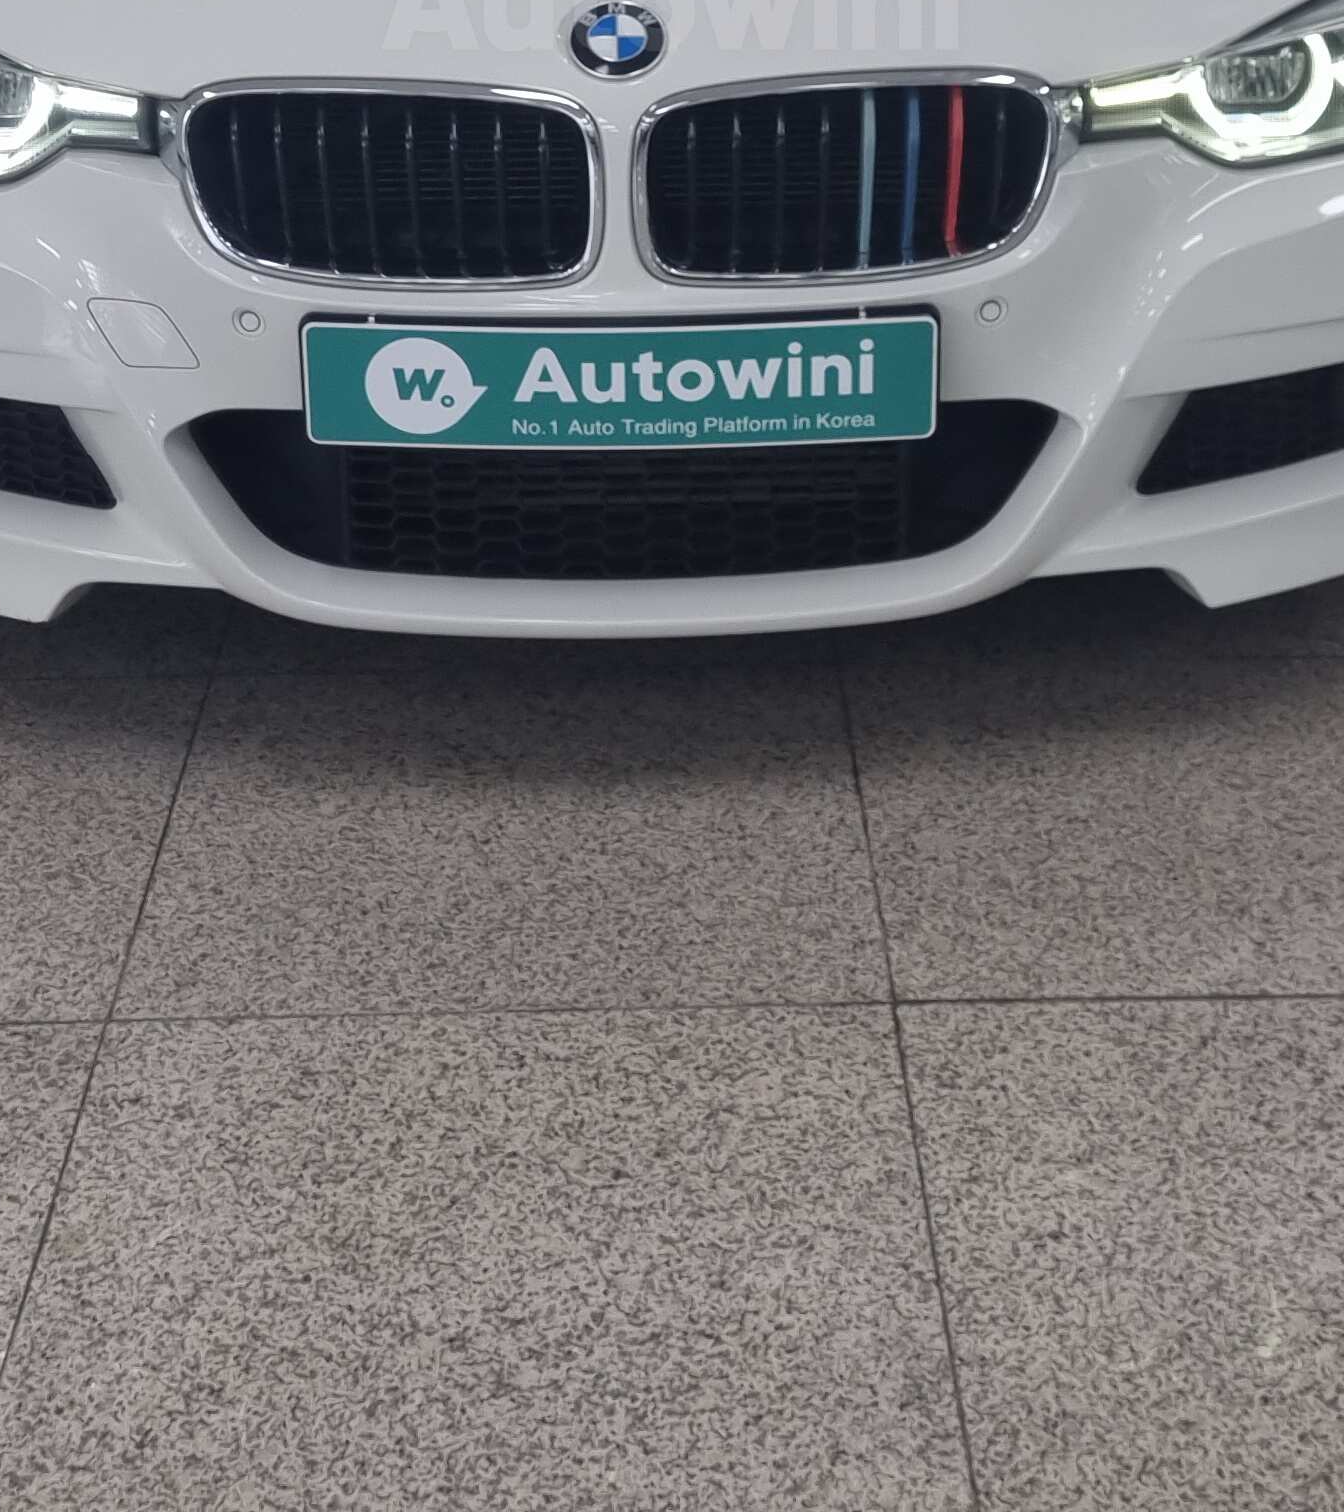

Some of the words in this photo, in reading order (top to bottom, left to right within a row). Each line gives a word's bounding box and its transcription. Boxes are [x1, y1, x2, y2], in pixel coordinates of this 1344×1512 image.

[578, 2, 657, 26] BMW
[513, 338, 875, 404] Autowini
[512, 418, 558, 436] No.1
[567, 418, 615, 436] Auto
[621, 418, 698, 438] Trading
[703, 414, 788, 433] Platform
[793, 413, 812, 430] in
[816, 412, 876, 429] Korea
